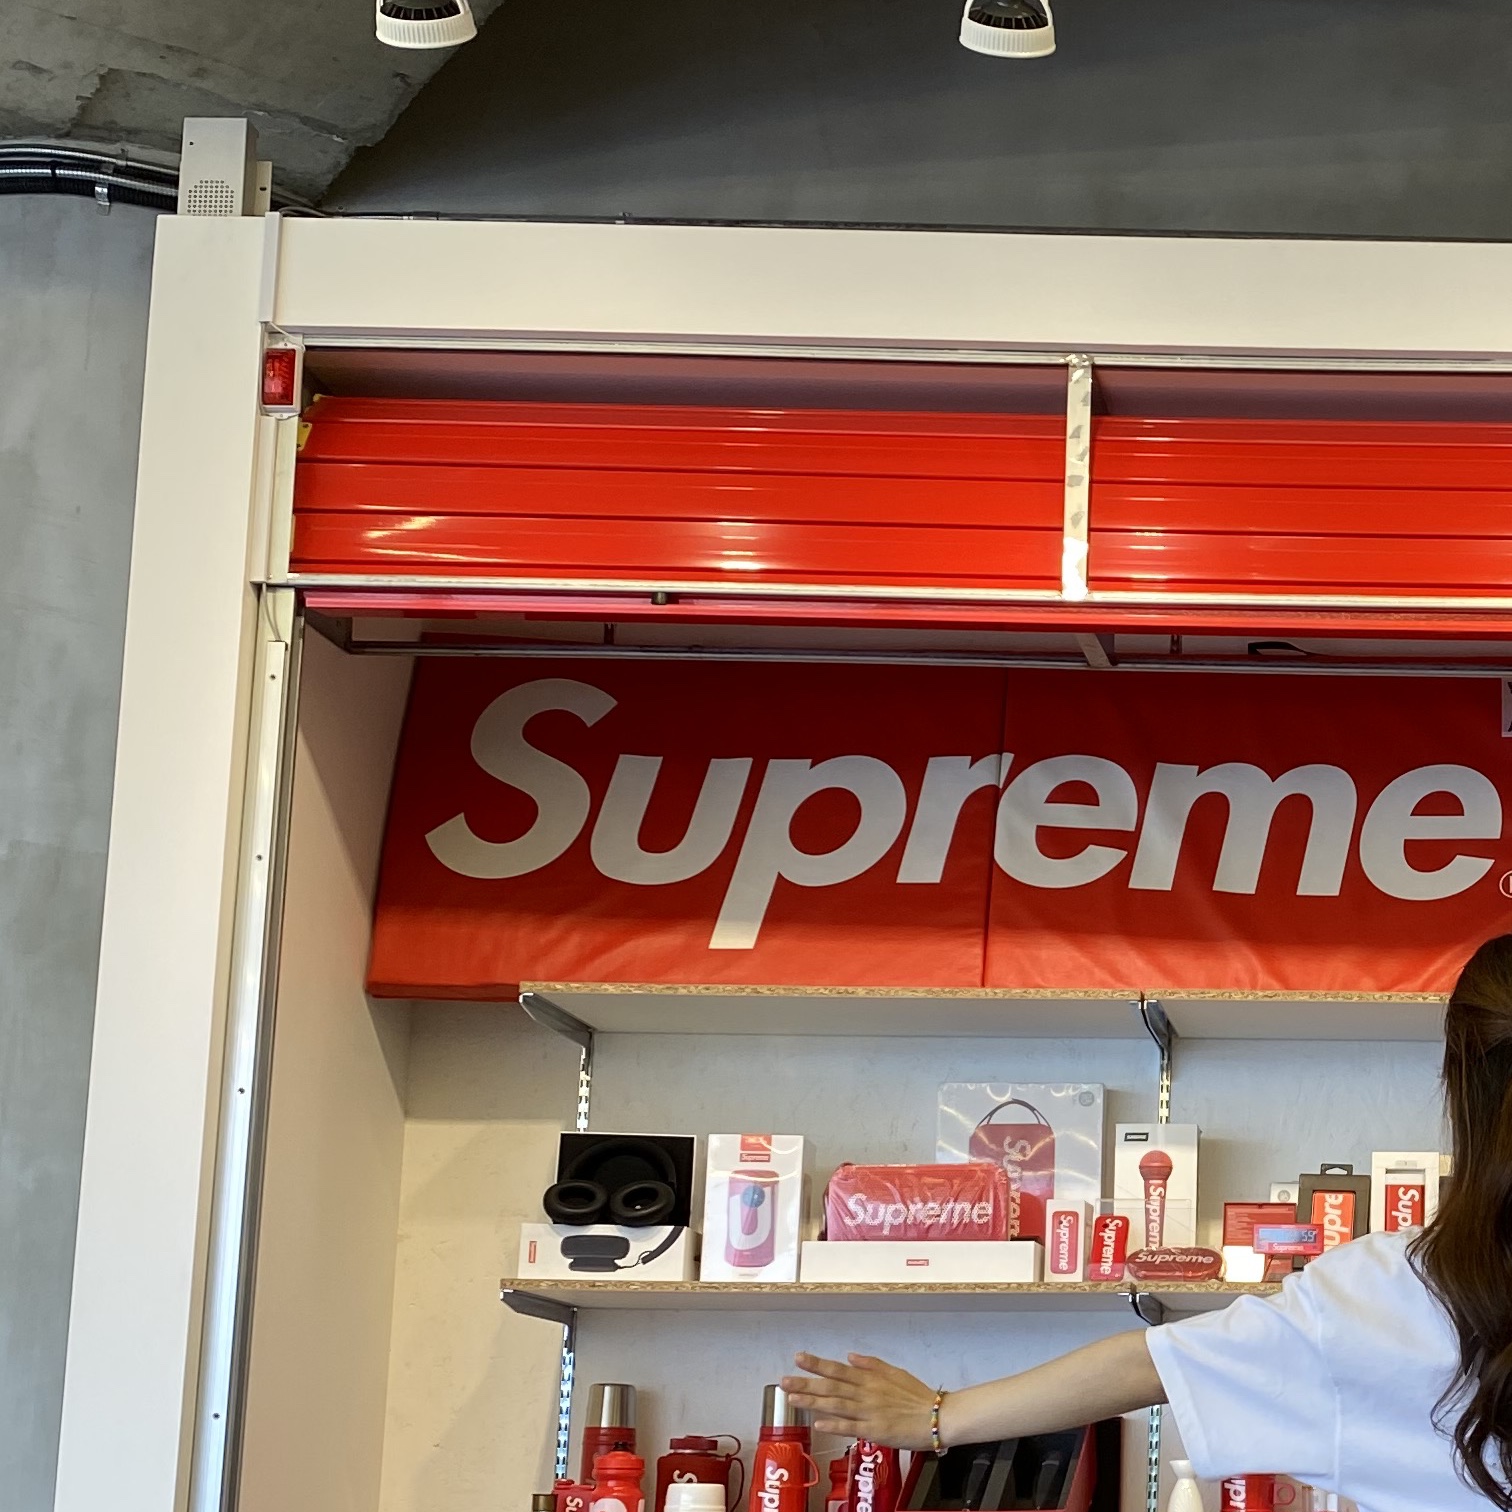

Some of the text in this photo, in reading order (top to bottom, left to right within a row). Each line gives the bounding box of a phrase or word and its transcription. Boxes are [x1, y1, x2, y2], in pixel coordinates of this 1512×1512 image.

[425, 678, 1503, 950] Supreme
[844, 1192, 993, 1236] Supreme
[1148, 1185, 1165, 1251] Suprem
[1391, 1186, 1420, 1232] Sup
[1055, 1214, 1074, 1271] Supreme
[1098, 1218, 1123, 1275] Supreme
[1135, 1250, 1215, 1265] Supreme
